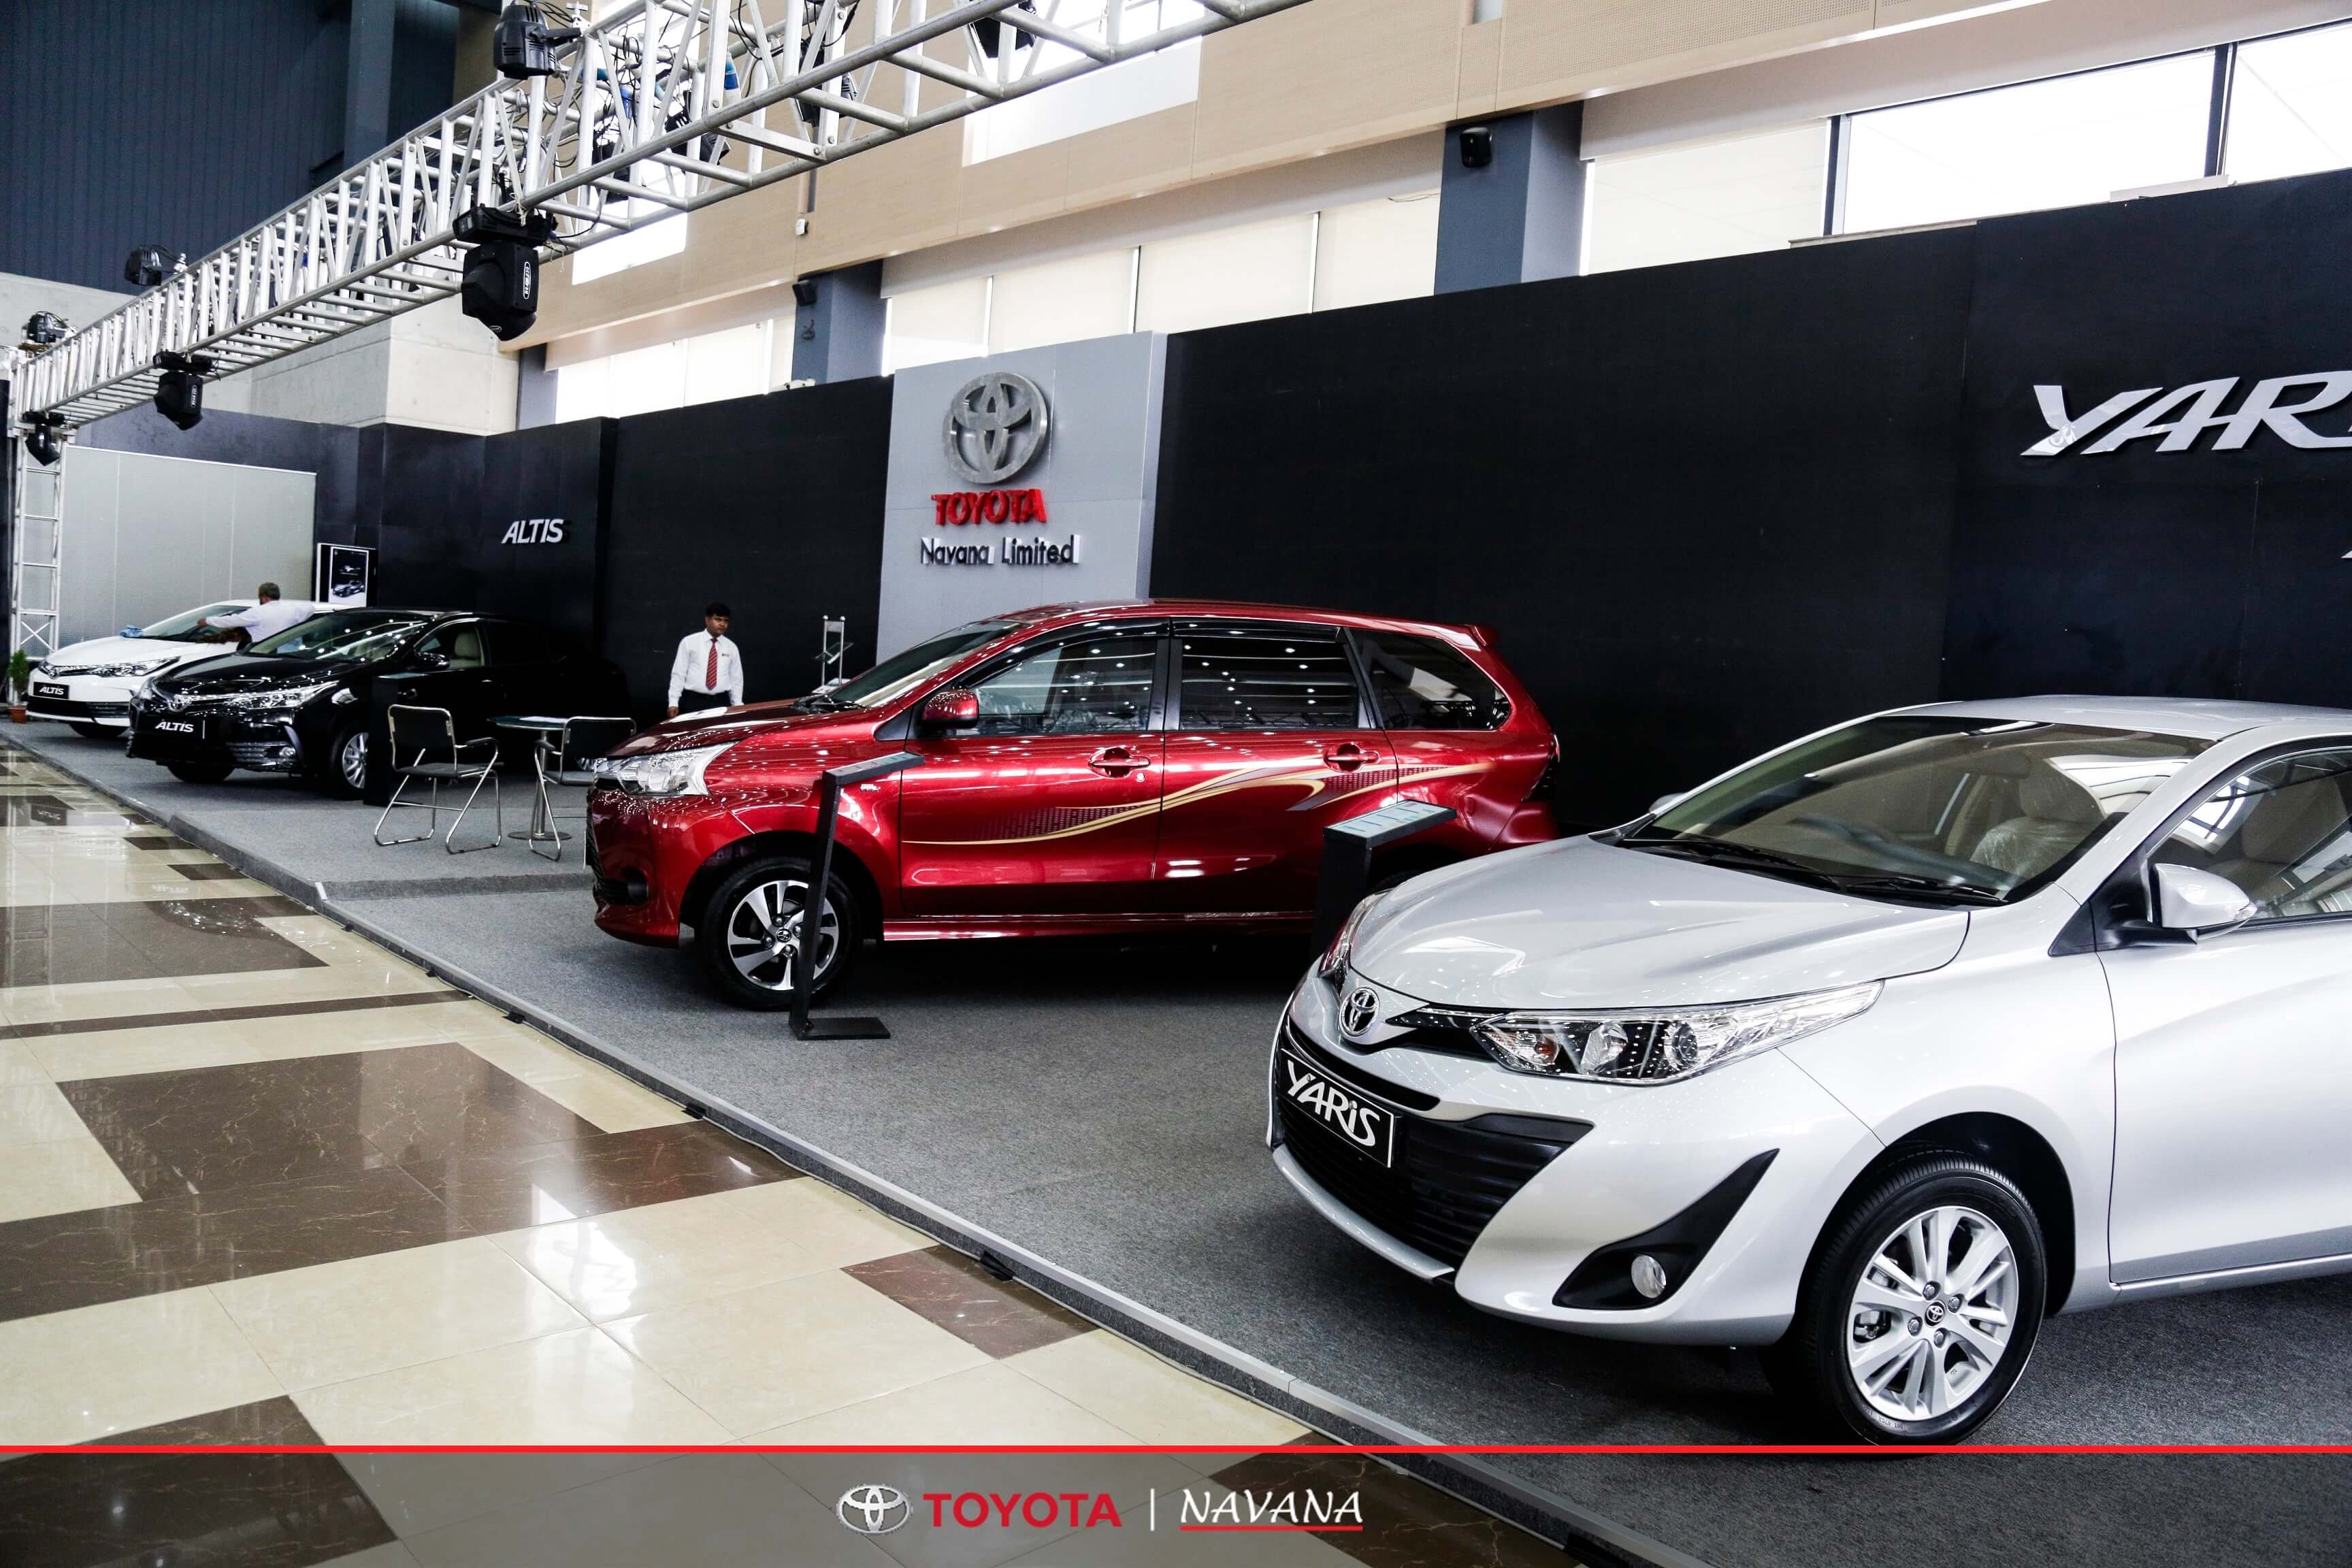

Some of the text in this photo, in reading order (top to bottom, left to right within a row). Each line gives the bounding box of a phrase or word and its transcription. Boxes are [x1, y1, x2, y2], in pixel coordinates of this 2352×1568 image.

[2020, 370, 2352, 456] YAR
[931, 489, 1047, 526] TOYOTA
[501, 519, 564, 544] ALTIS
[921, 534, 1081, 565] Navana Limited
[38, 685, 65, 696] ALTIS
[154, 721, 195, 734] ALTIS
[1287, 1059, 1380, 1147] YARIS
